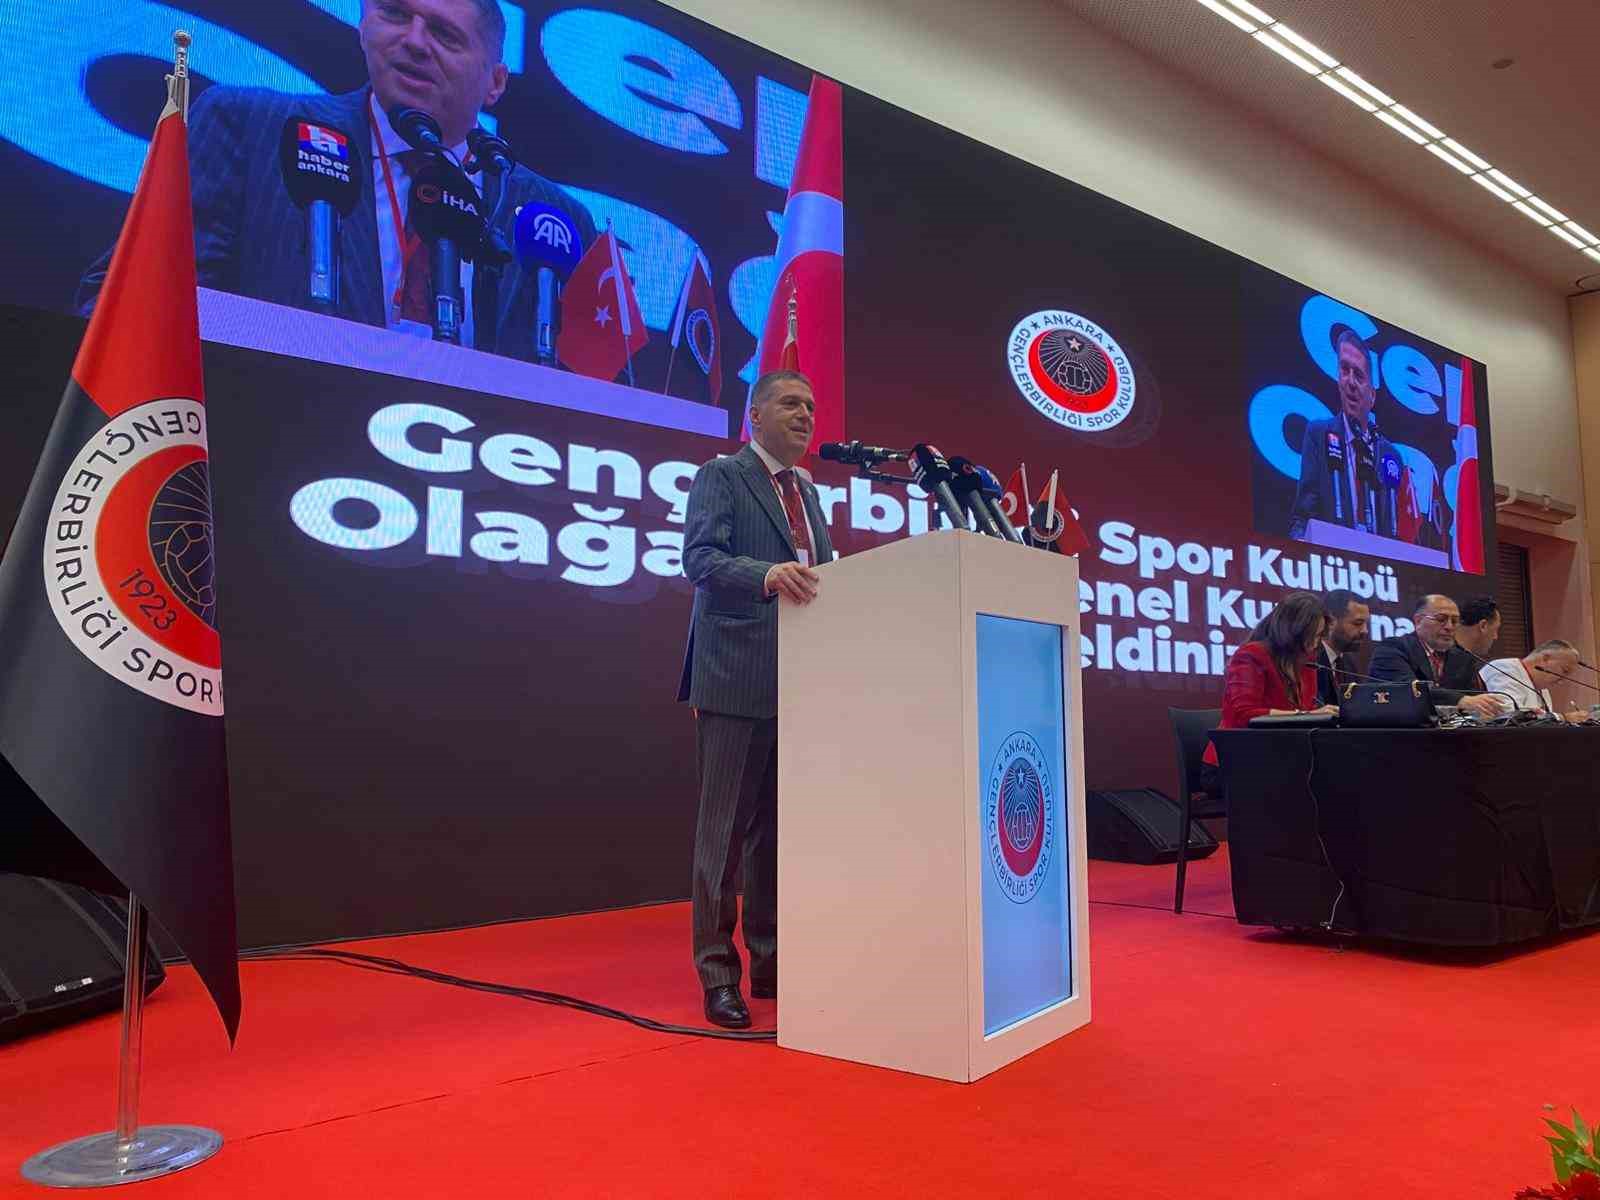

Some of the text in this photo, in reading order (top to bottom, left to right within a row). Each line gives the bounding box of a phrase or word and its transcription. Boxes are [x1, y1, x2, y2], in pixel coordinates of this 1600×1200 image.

[297, 149, 350, 172] haber
[297, 161, 350, 183] ankara
[534, 220, 571, 254] AA
[1043, 313, 1105, 344] ANKARA
[1009, 327, 1083, 428] GENÇLERBİRLİĞİ
[1086, 407, 1122, 428] SPOR
[54, 410, 214, 705] GENÇLERBİRLİĞİ SPOR
[1099, 521, 1233, 579] Spor
[1248, 544, 1399, 603] Kulübü
[119, 568, 178, 631] 1923
[1003, 738, 1036, 762] ANKARA
[1028, 854, 1048, 892] SPOR
